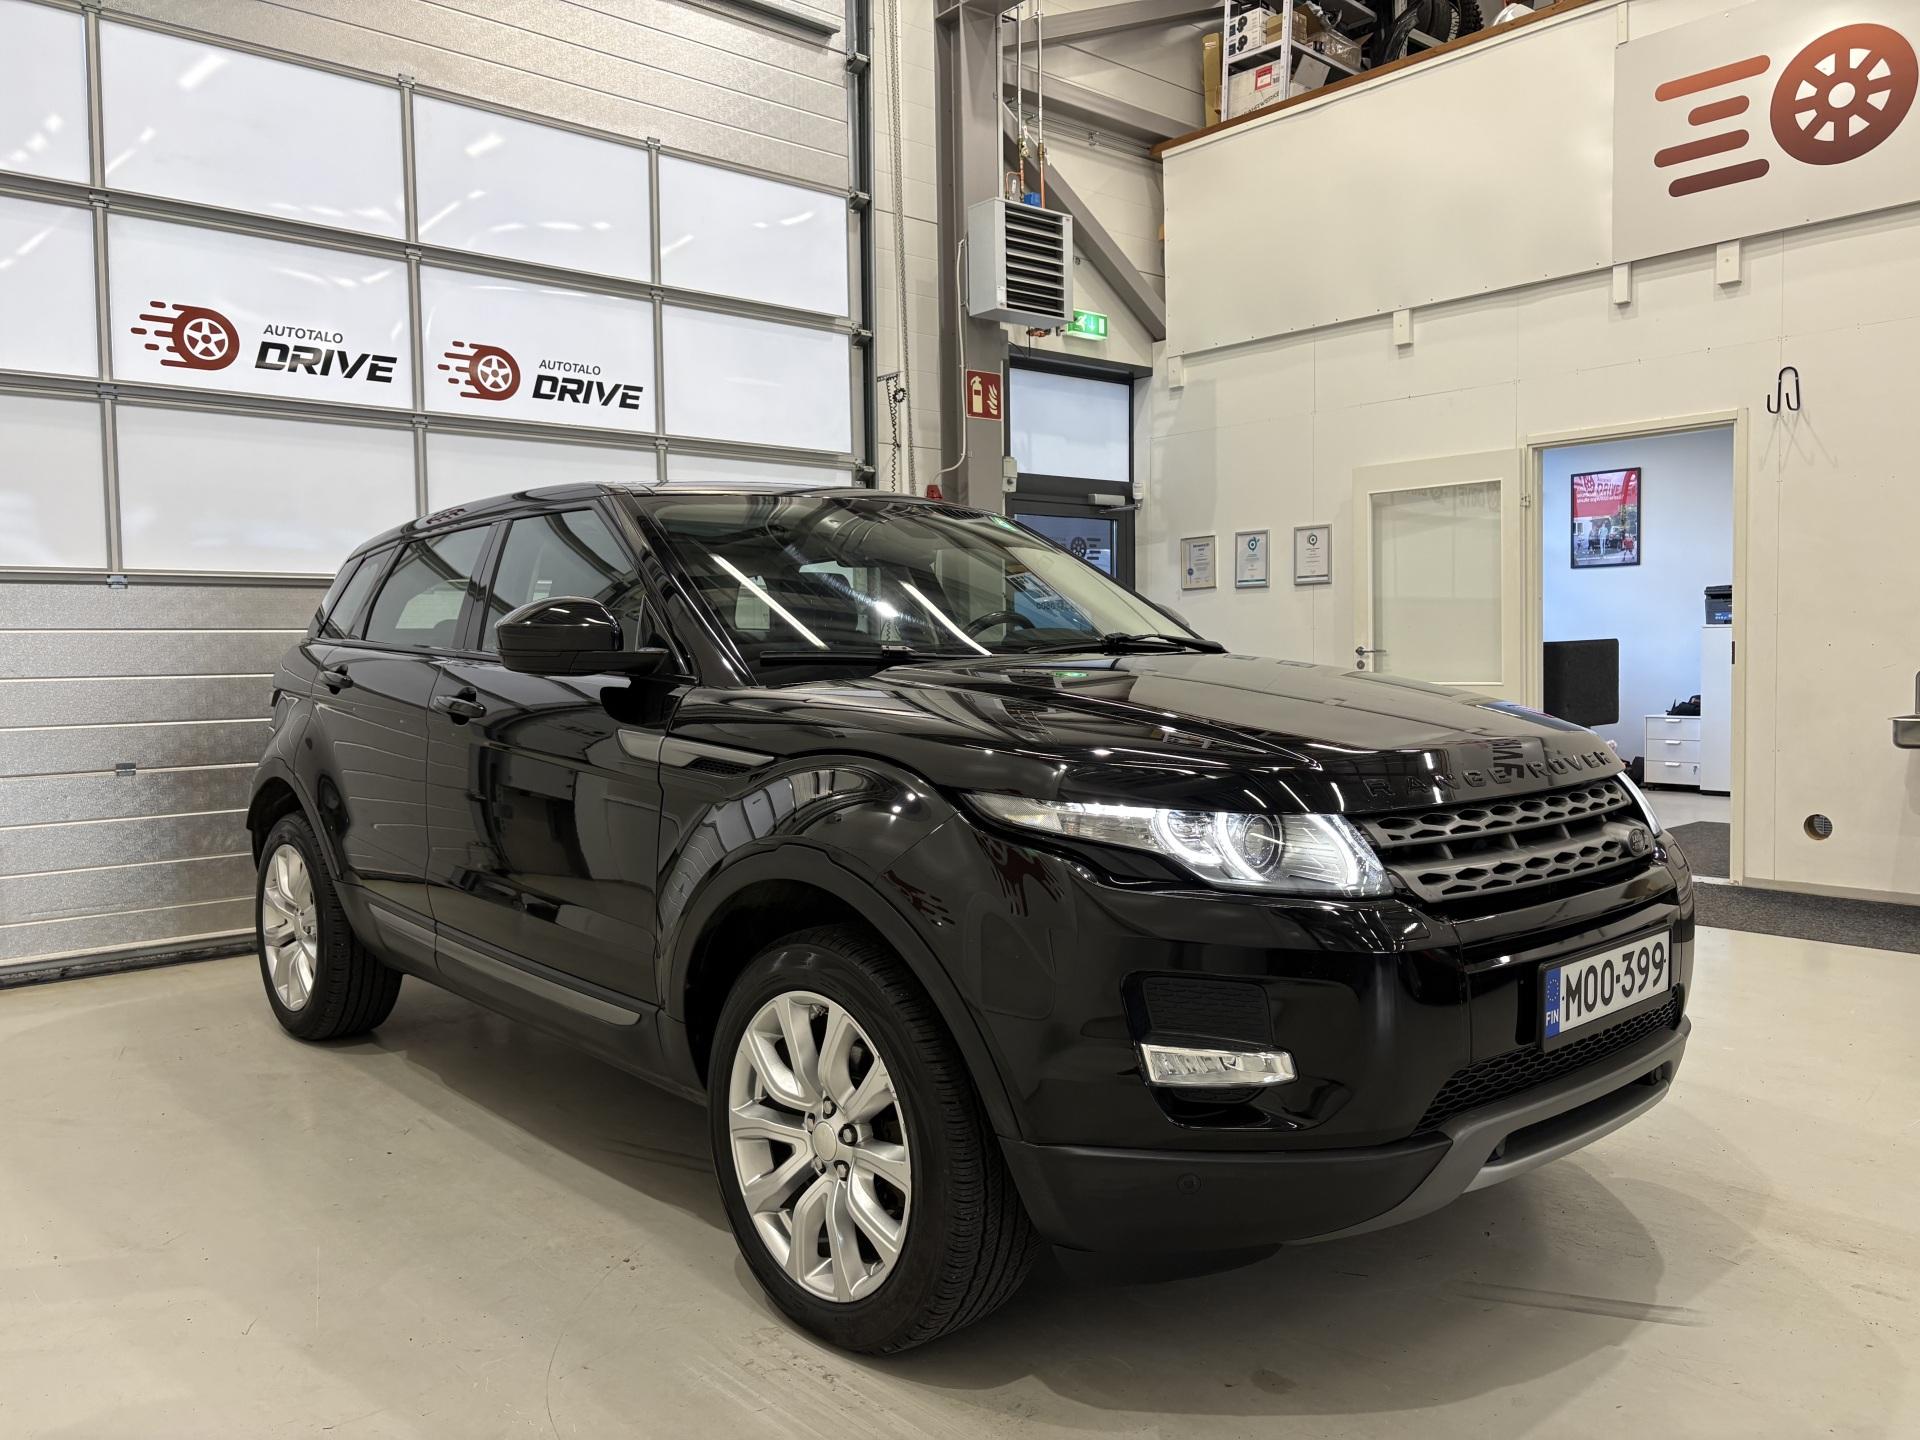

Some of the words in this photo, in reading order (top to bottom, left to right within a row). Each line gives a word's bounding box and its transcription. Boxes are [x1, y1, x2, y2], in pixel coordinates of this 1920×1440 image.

[263, 324, 344, 344] AUTOTALO
[254, 341, 398, 383] DRIVE
[538, 359, 601, 375] AUTOTALO
[532, 374, 644, 410] DRIVE
[1362, 768, 1512, 798] RANGE
[1526, 751, 1612, 779] ROVER
[1565, 941, 1665, 1022] MOO-399
[1545, 1009, 1560, 1027] FIN
